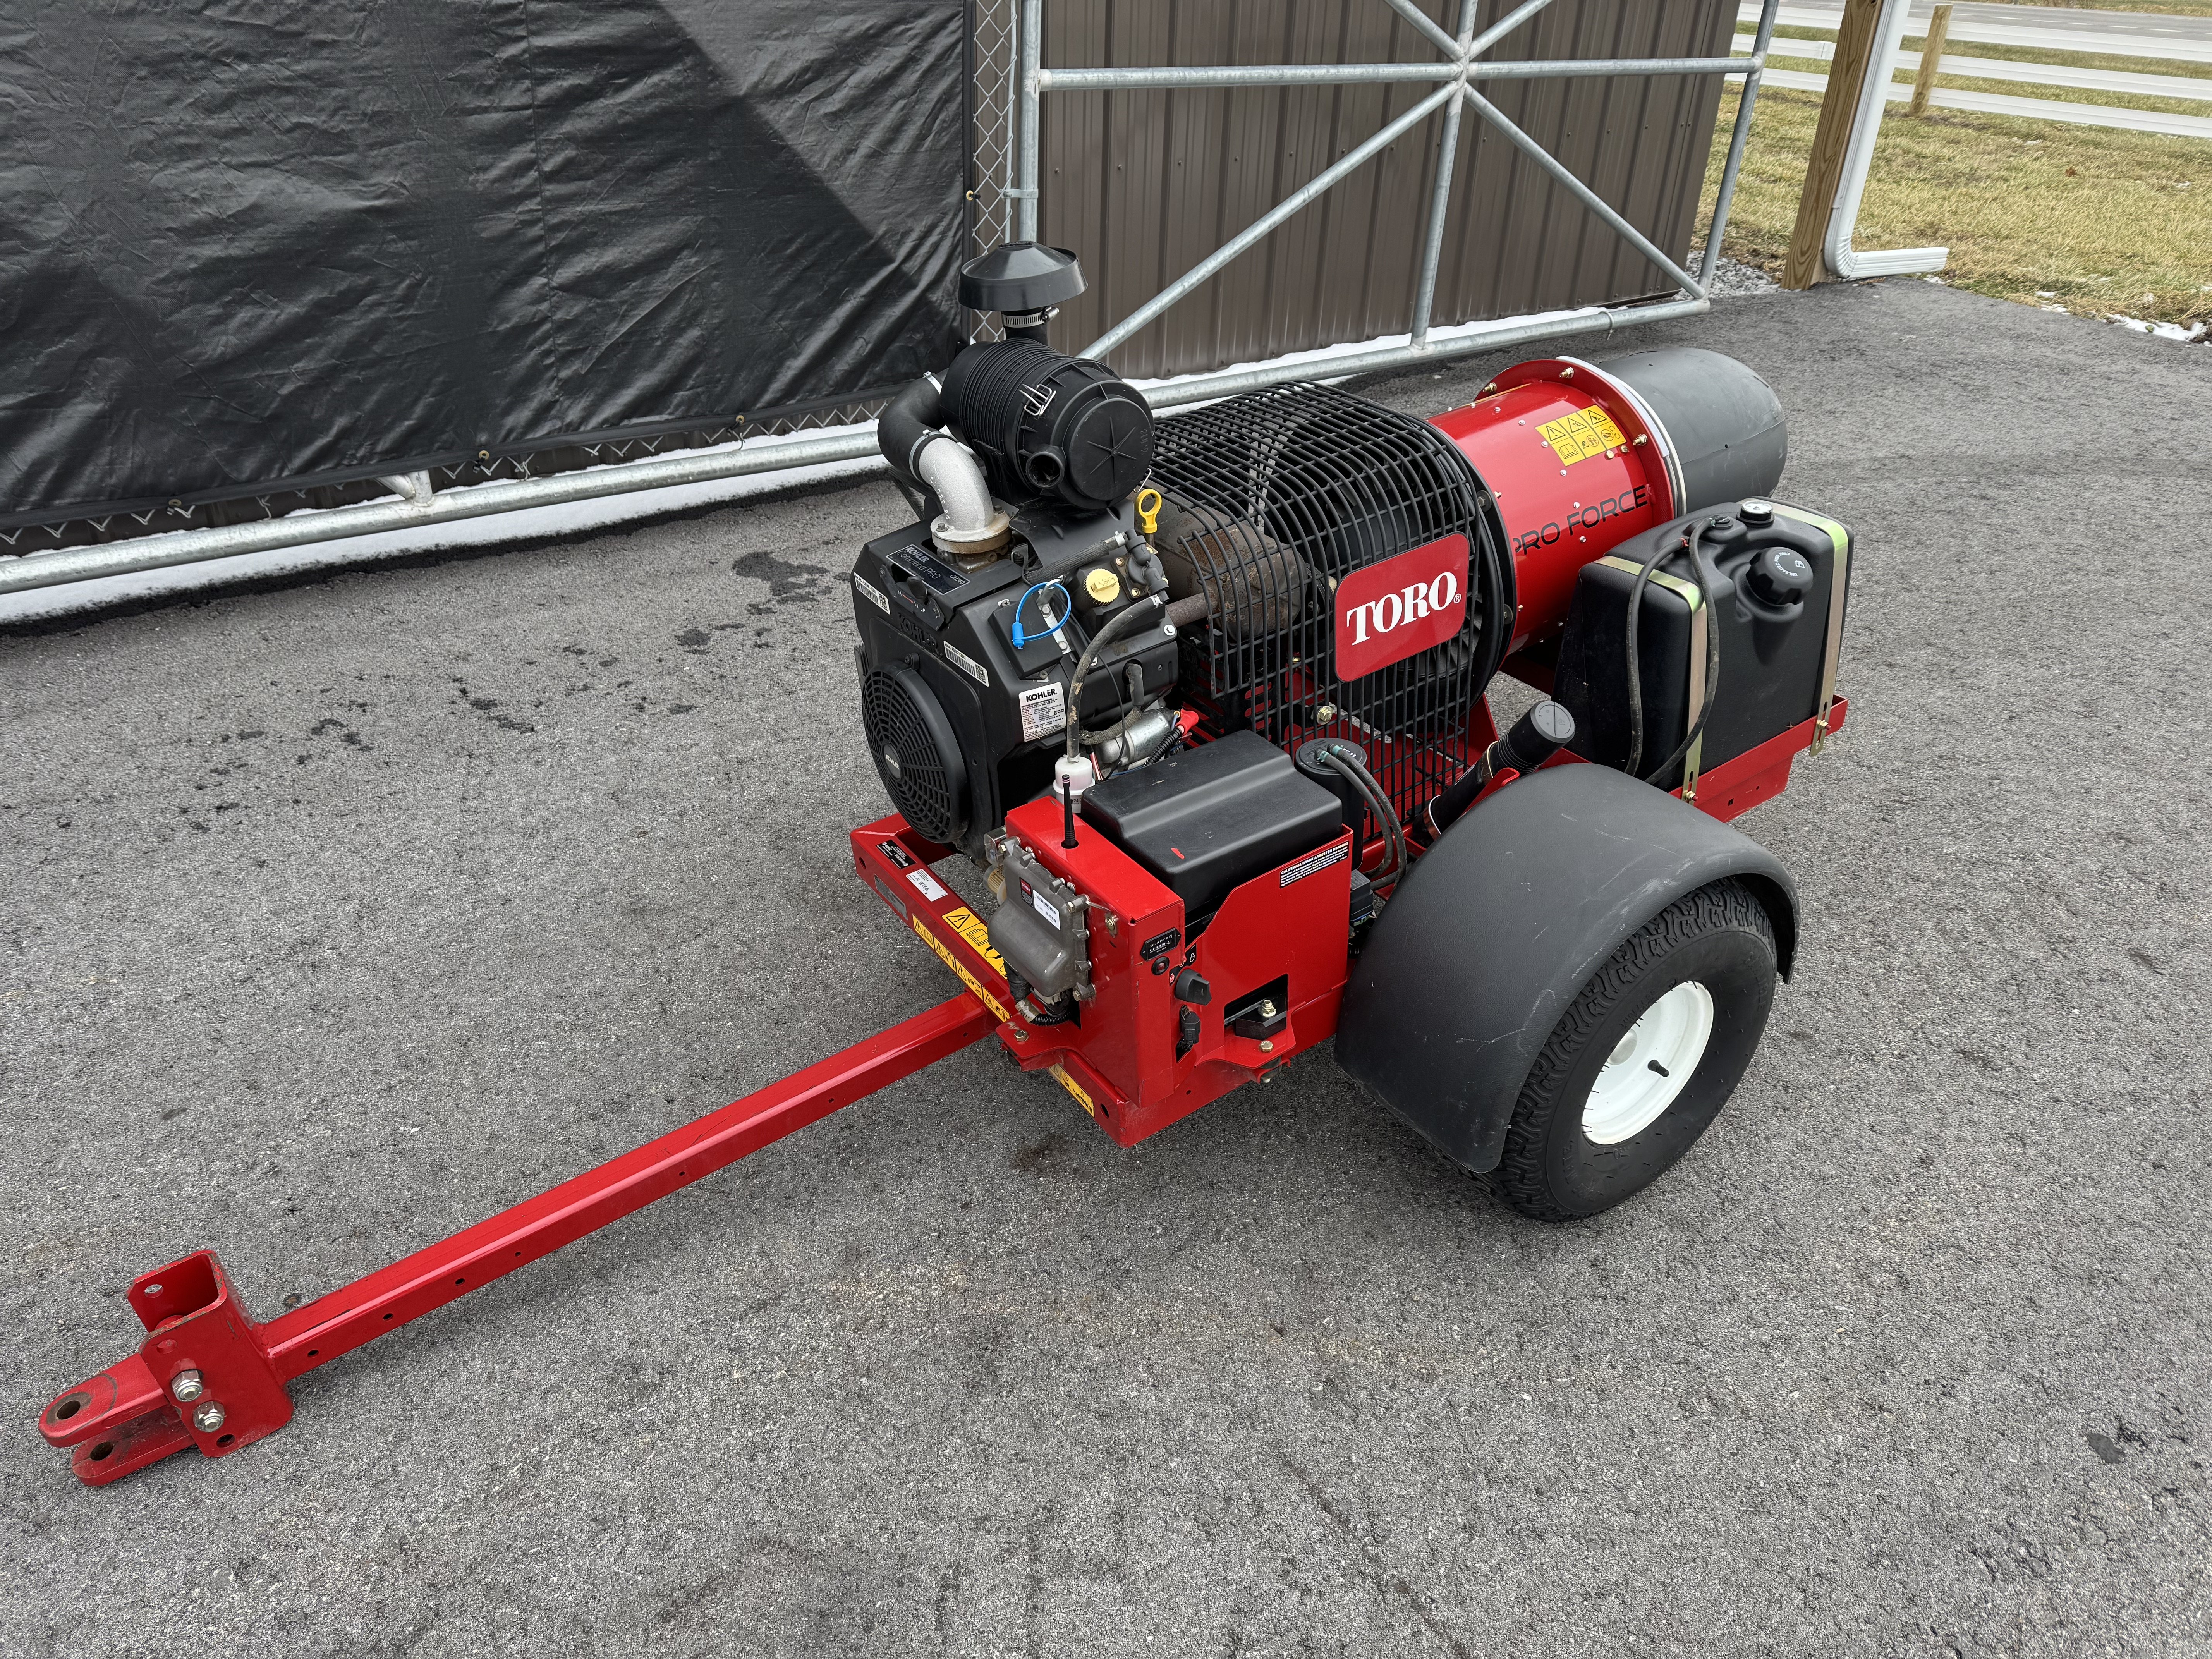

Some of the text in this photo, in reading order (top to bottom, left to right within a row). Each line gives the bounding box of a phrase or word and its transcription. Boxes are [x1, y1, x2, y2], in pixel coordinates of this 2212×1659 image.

[1567, 484, 1648, 536] FORCE
[905, 546, 930, 563] KOHLER
[897, 550, 941, 579] Command PRO
[1775, 562, 1798, 577] UNLEADED
[950, 574, 966, 585] CH740
[885, 753, 900, 770] KOHLER
[1281, 862, 1302, 874] CALIFORNIA
[1333, 842, 1348, 851] WARNING
[1150, 937, 1168, 947] QUARTZ
